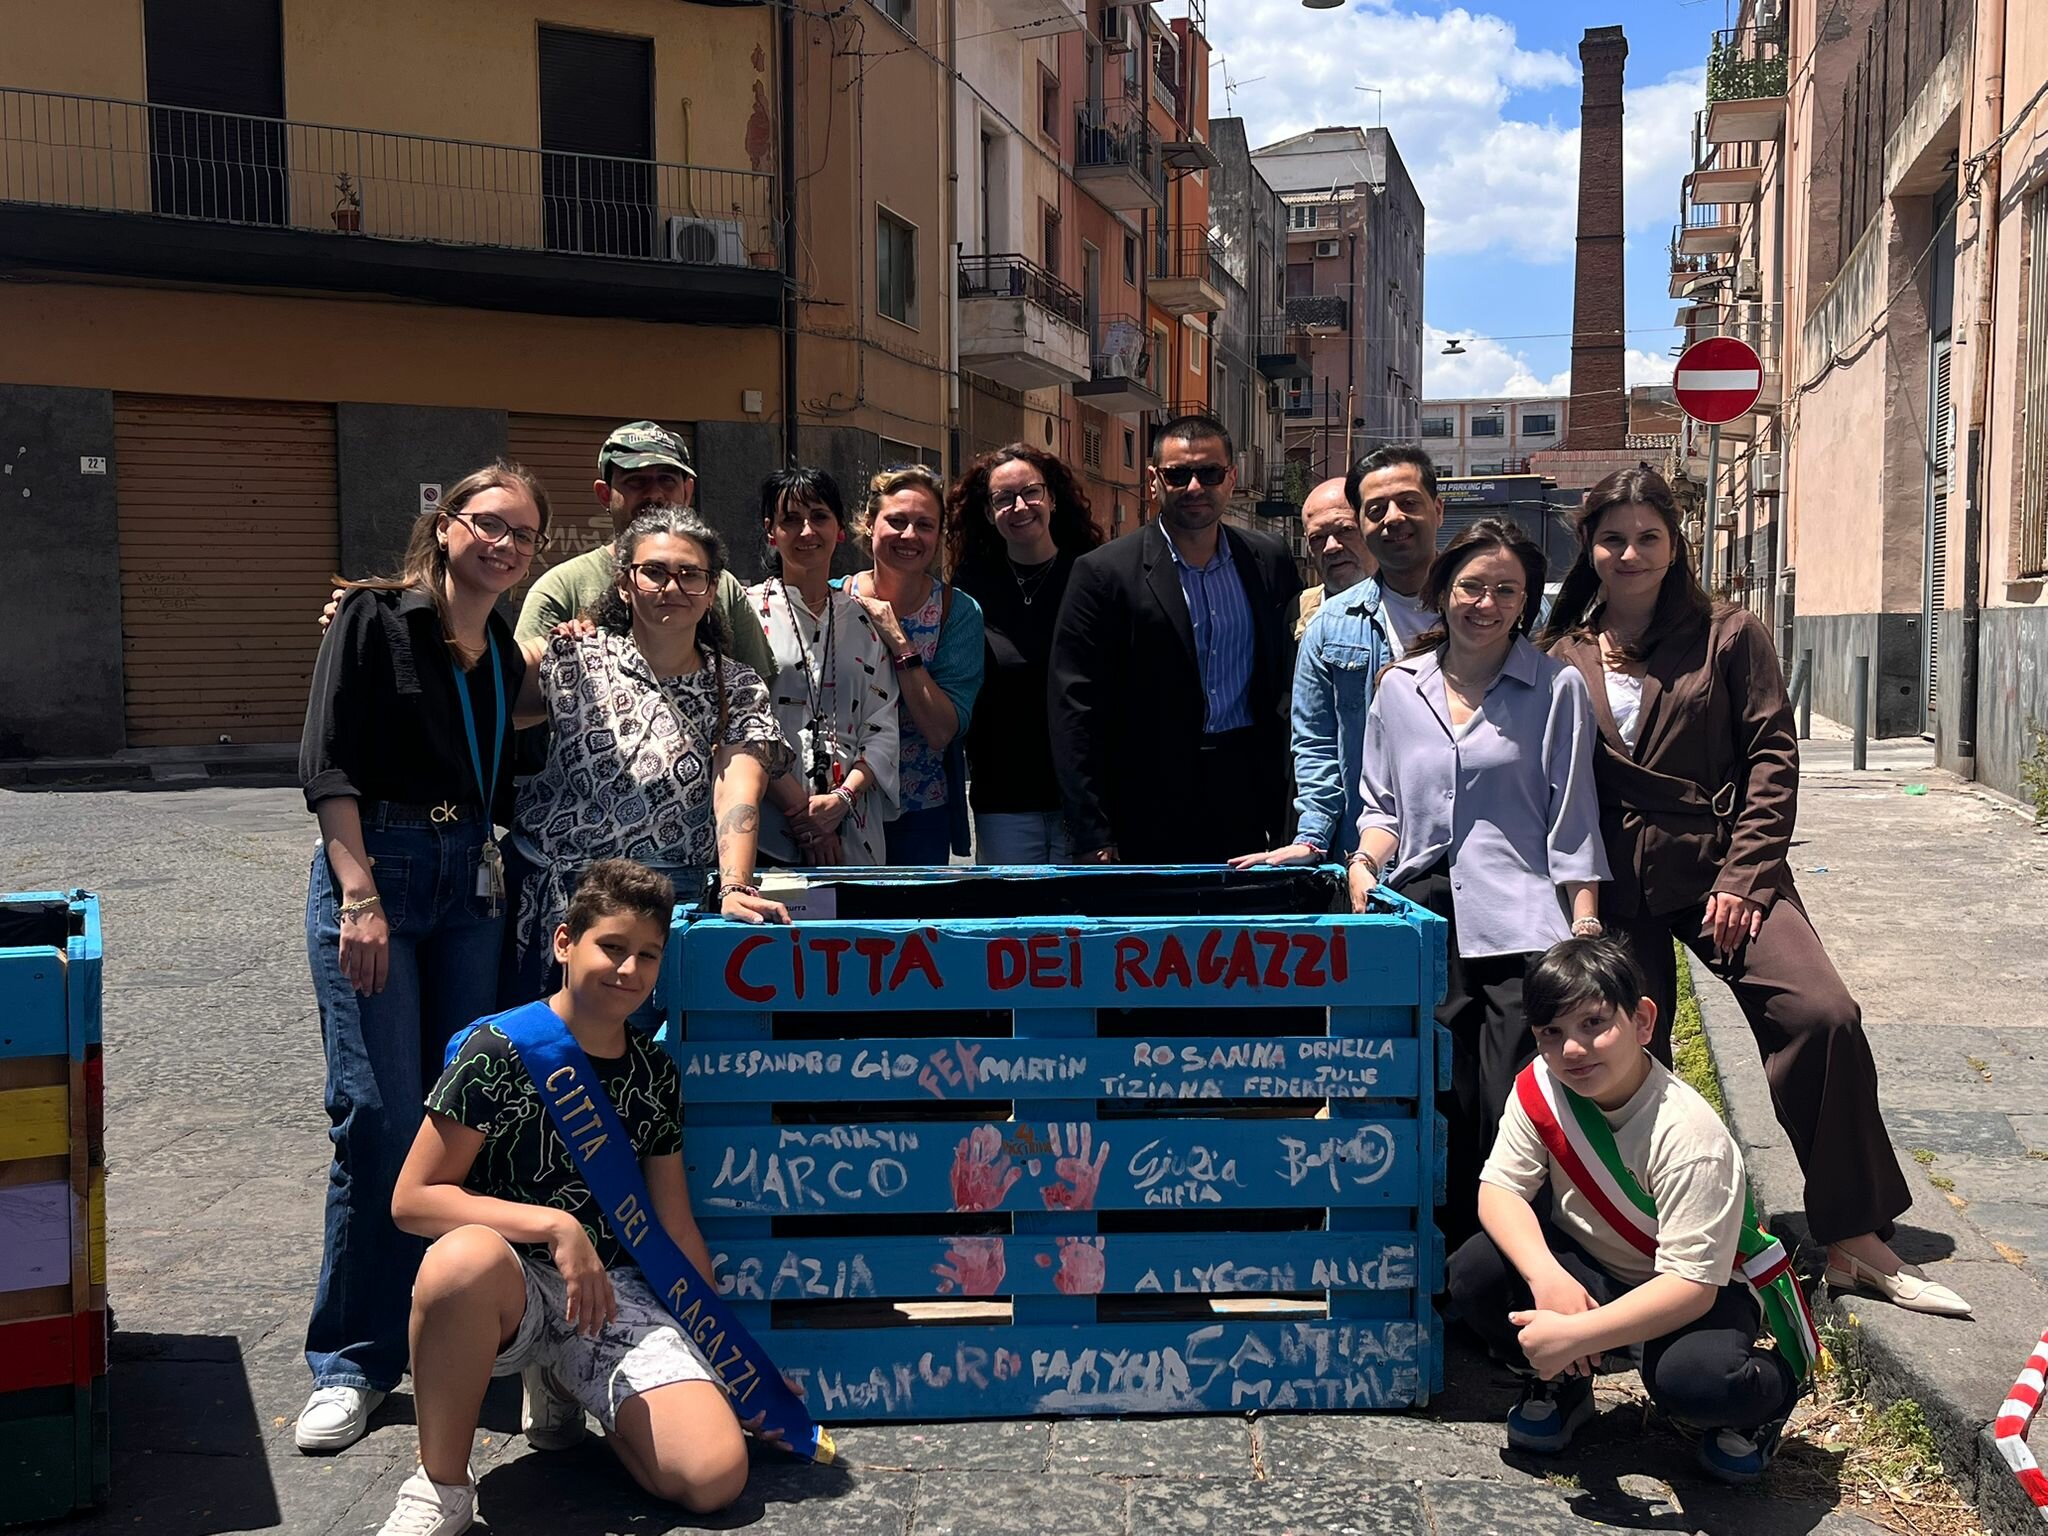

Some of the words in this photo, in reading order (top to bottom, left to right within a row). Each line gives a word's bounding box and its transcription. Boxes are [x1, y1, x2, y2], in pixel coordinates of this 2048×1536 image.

[88, 458, 98, 468] 22
[1448, 482, 1481, 491] PARKING
[430, 800, 458, 822] ck
[786, 904, 807, 912] urra
[1133, 1042, 1286, 1073] ROSANNA
[1298, 1039, 1395, 1061] ORNELLA
[685, 1050, 842, 1077] ALESSANDRO
[1315, 1066, 1378, 1085] JULIE
[711, 1147, 908, 1208] MARCO
[711, 1250, 877, 1300] GRAZIA
[1311, 1244, 1416, 1290] ALICE
[614, 1193, 650, 1248] DEI
[667, 1278, 761, 1403] RAGAZZI
